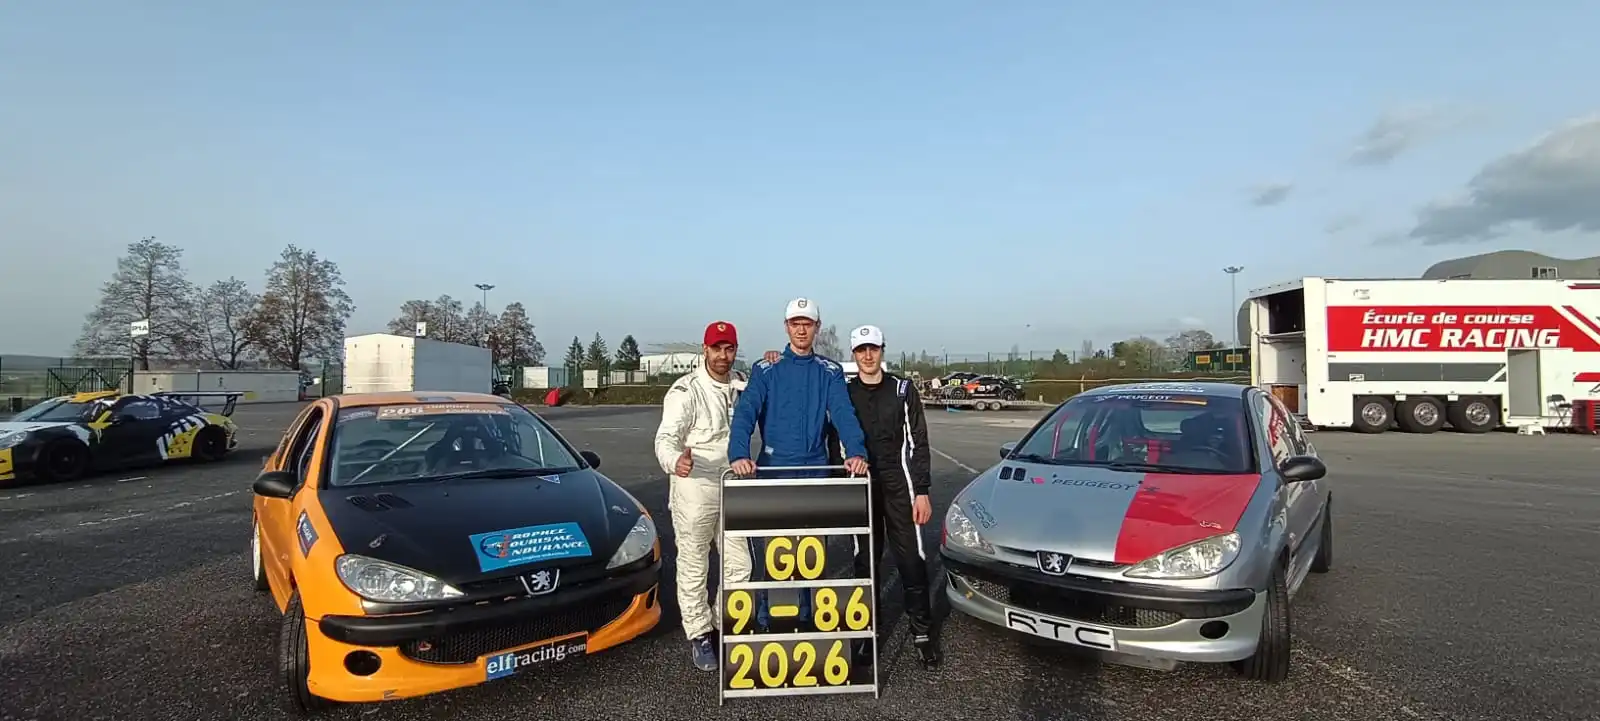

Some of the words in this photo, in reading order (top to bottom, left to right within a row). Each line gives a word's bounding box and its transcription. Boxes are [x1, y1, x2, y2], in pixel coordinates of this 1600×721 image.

[1362, 309, 1426, 325] Écurie
[1431, 312, 1459, 325] de
[1463, 314, 1535, 325] course
[1360, 328, 1431, 348] HMC
[1439, 328, 1560, 348] RACING
[381, 407, 424, 417] 206
[1051, 478, 1136, 491] PEUGEOT
[765, 536, 825, 581] GO
[1008, 611, 1111, 648] RTC
[729, 639, 849, 689] 2026
